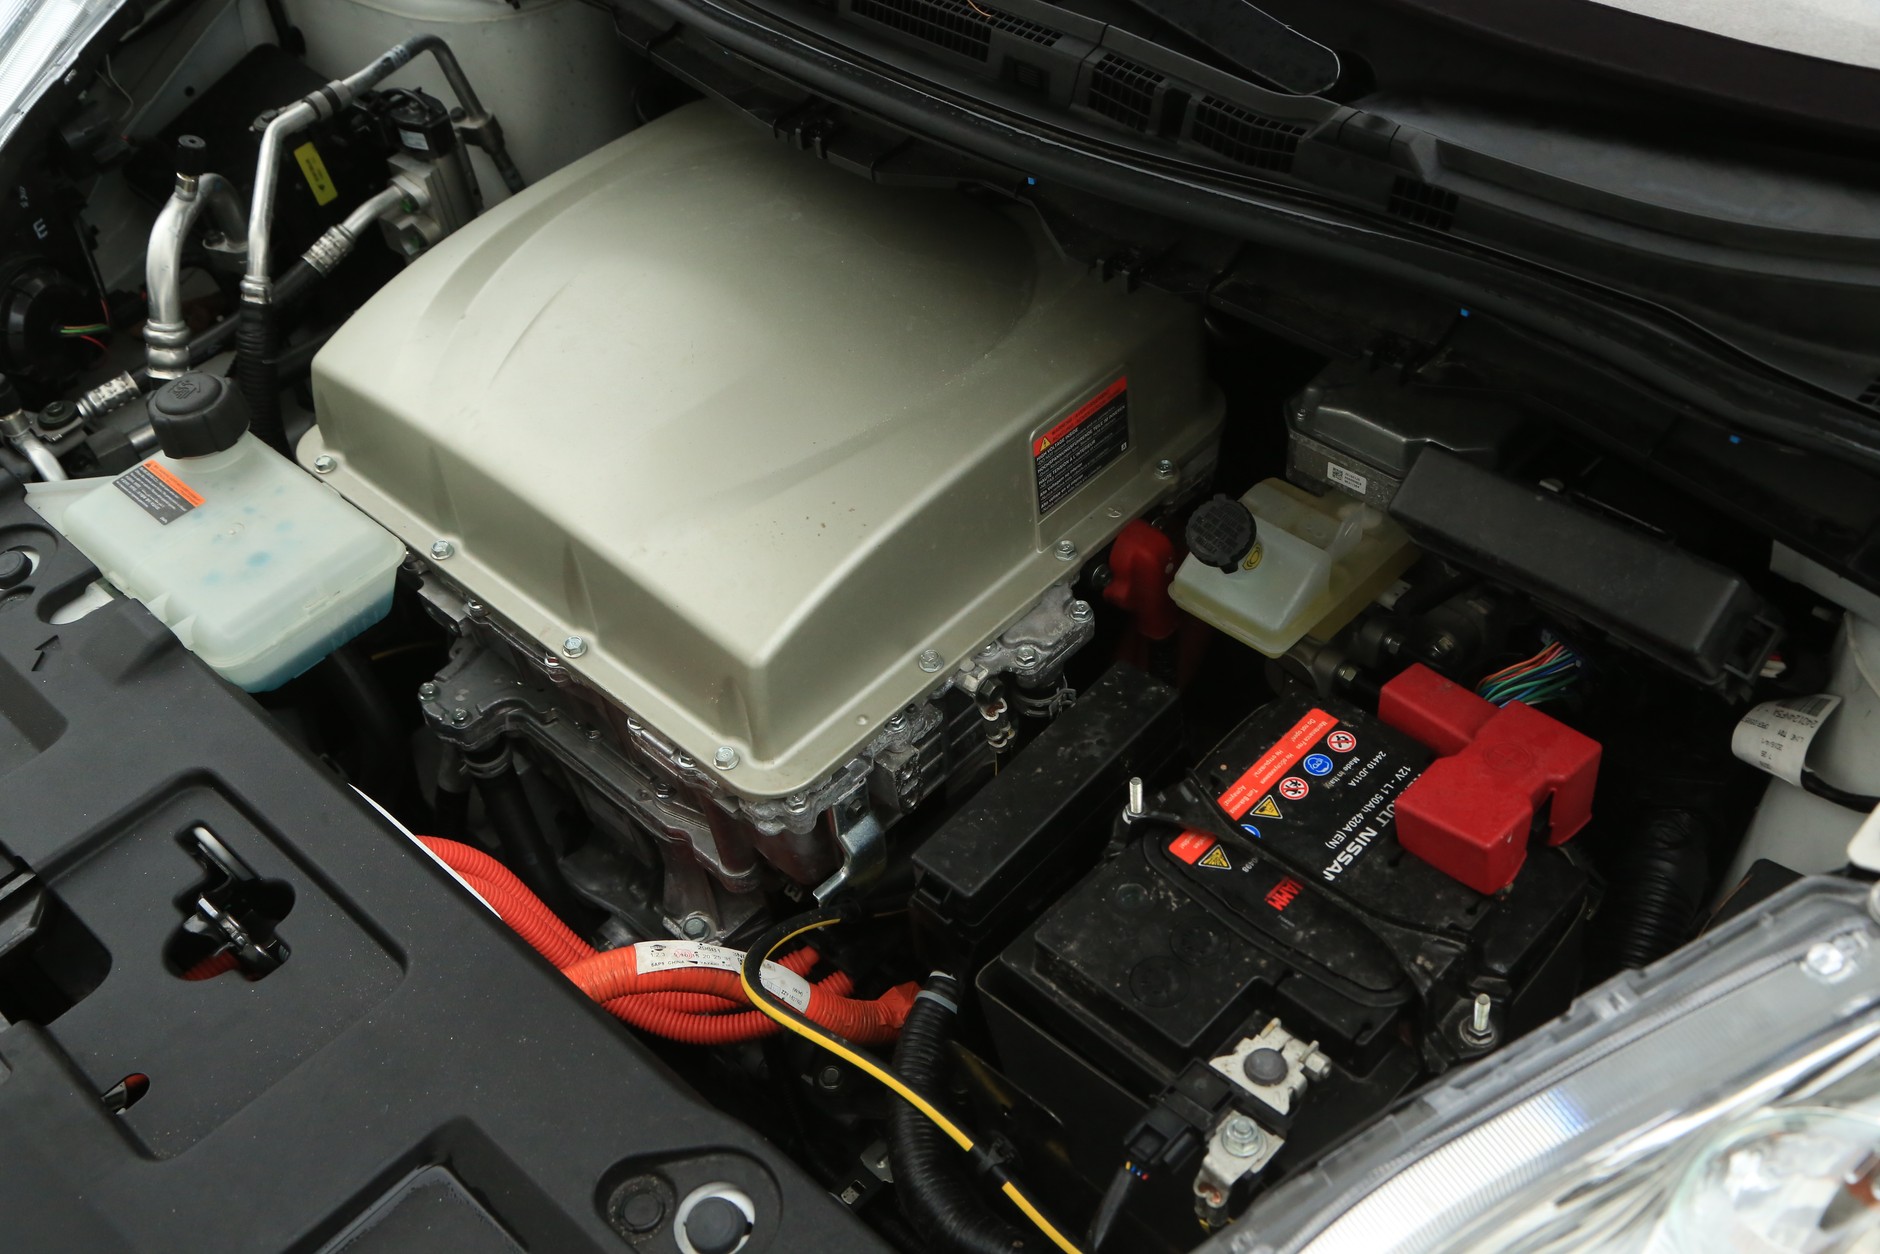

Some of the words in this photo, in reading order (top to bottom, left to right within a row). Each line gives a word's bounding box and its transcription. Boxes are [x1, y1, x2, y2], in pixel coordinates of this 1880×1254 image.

[1342, 756, 1360, 771] Made
[1365, 750, 1387, 769] 24410
[1347, 767, 1370, 787] JD11A
[1392, 764, 1411, 780] 12V
[1322, 775, 1340, 789] Italy
[1379, 783, 1394, 794] L1
[1360, 793, 1384, 813] 50Ah
[1341, 812, 1365, 832] 420A
[1323, 829, 1347, 849] (EN)
